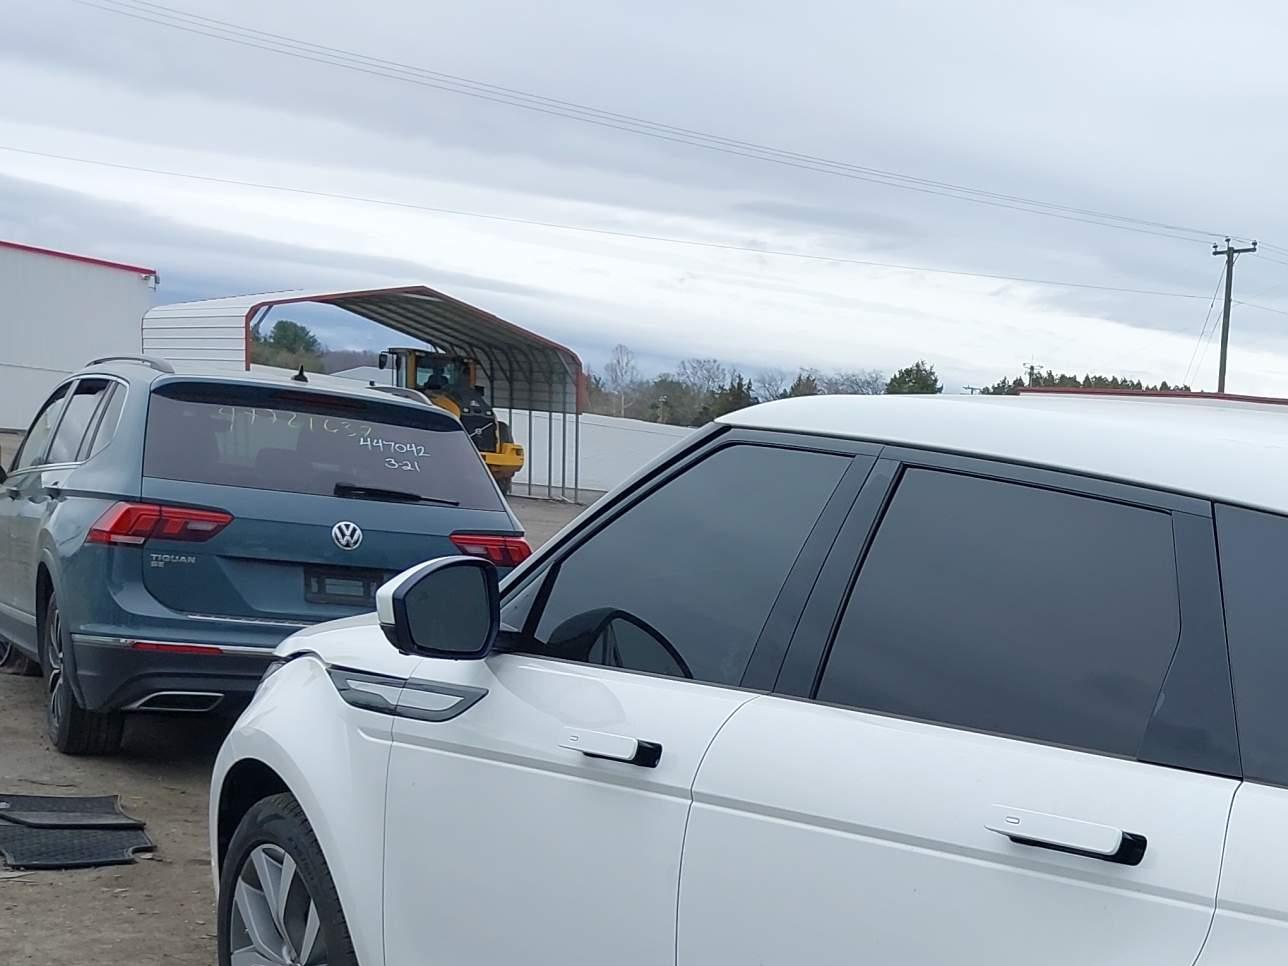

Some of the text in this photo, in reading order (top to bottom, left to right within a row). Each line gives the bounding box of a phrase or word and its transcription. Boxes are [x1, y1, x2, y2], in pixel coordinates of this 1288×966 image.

[359, 437, 431, 457] 447042
[384, 458, 421, 473] 3-21
[150, 553, 196, 564] TIGUAN
